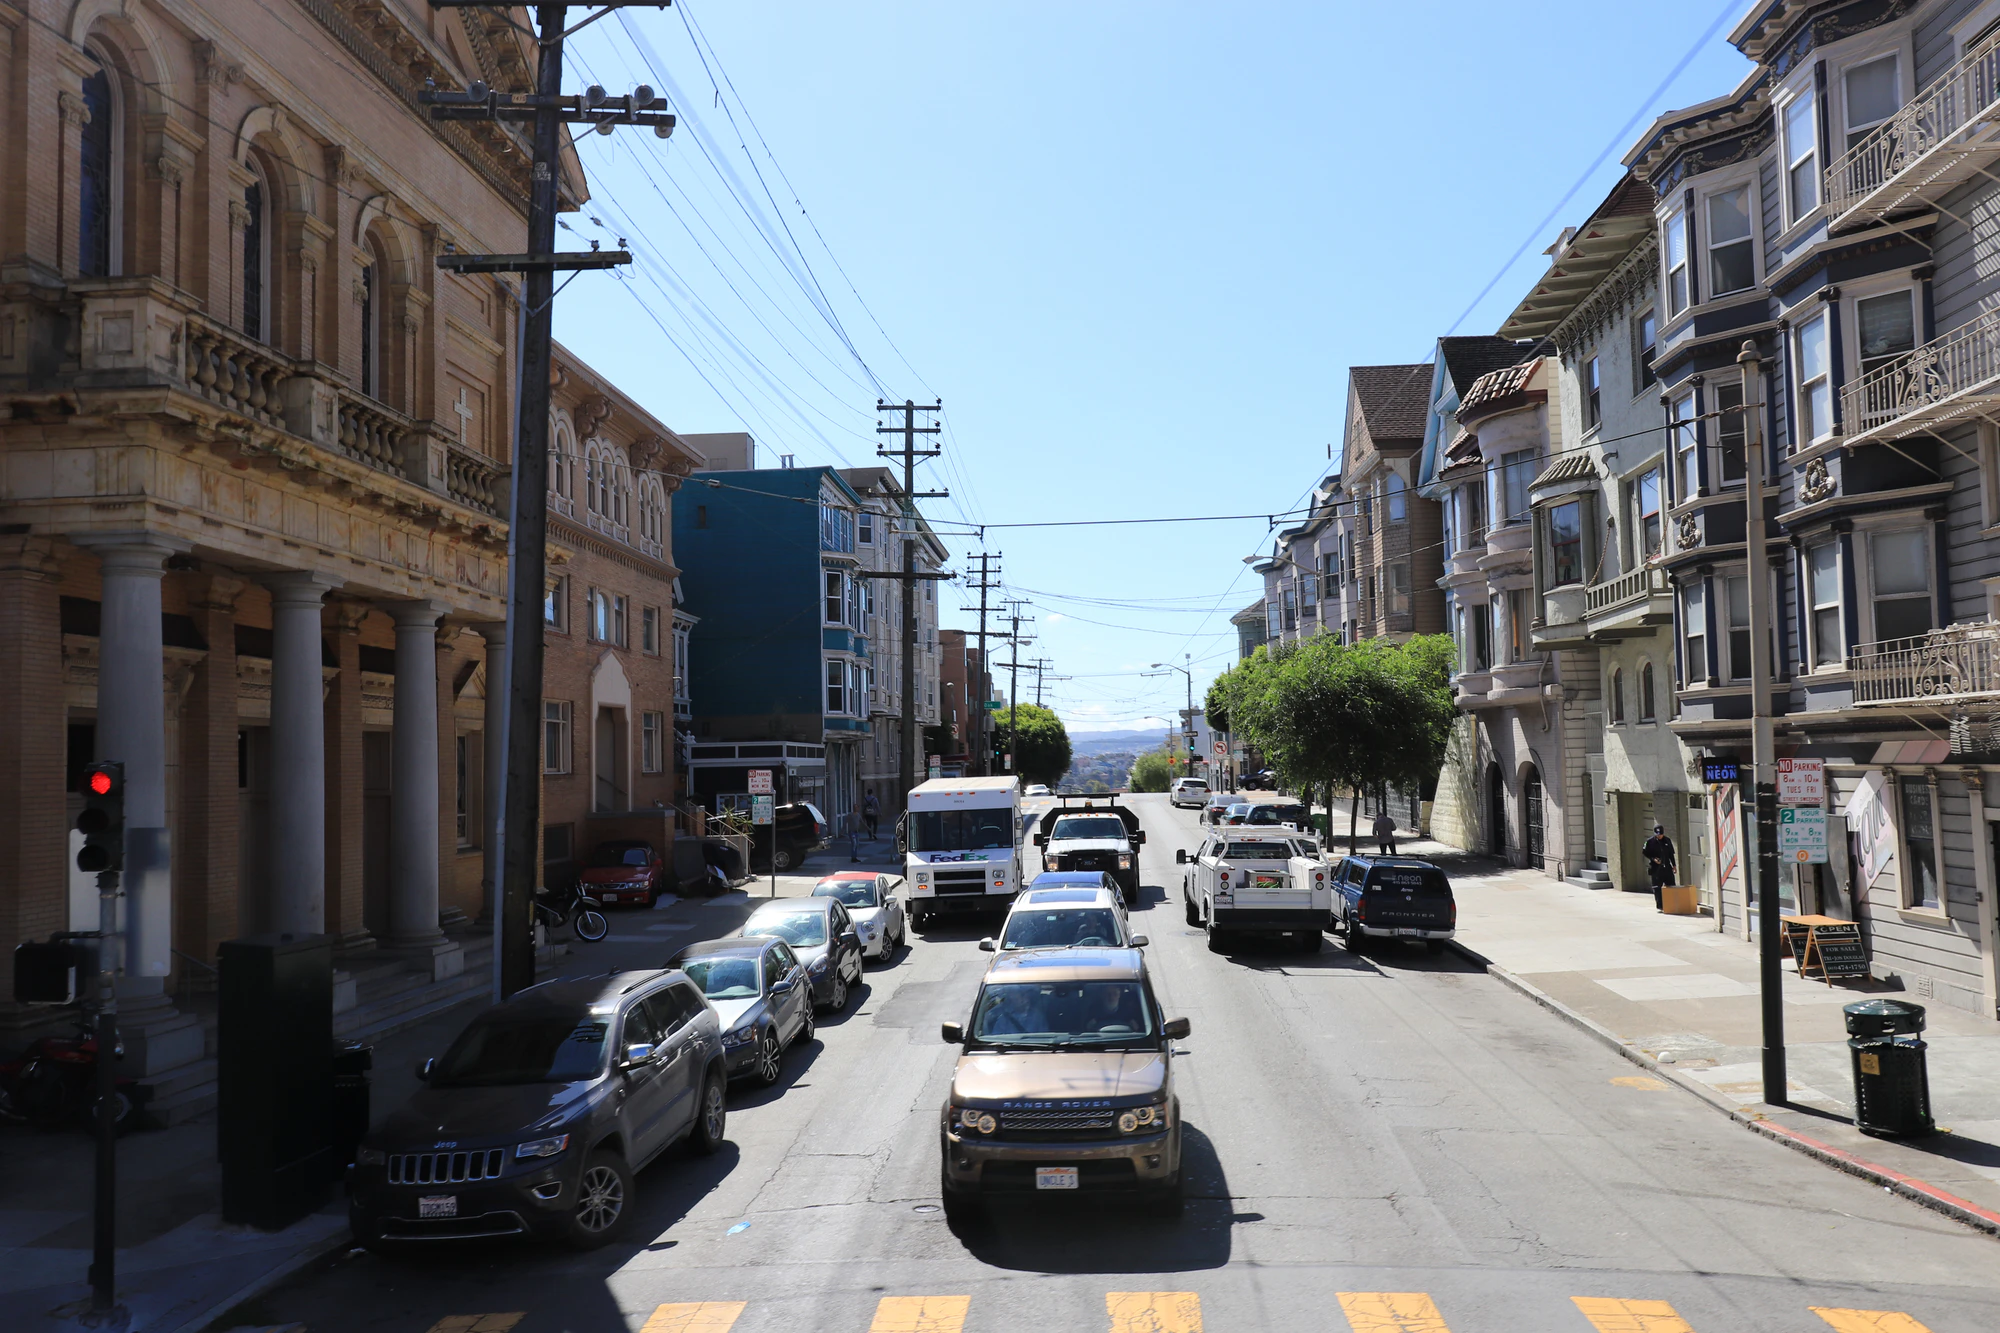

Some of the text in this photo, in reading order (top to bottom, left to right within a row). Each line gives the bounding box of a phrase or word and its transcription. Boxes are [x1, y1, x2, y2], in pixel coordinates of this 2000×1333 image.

[1780, 760, 1820, 772] NO PARKING
[1706, 770, 1737, 779] NEON
[1783, 811, 1792, 822] 2
[929, 853, 989, 862] FedEx
[1003, 1100, 1111, 1109] RANGE ROVER
[434, 1141, 457, 1149] Jeep
[1038, 1175, 1065, 1187] UNCLE
